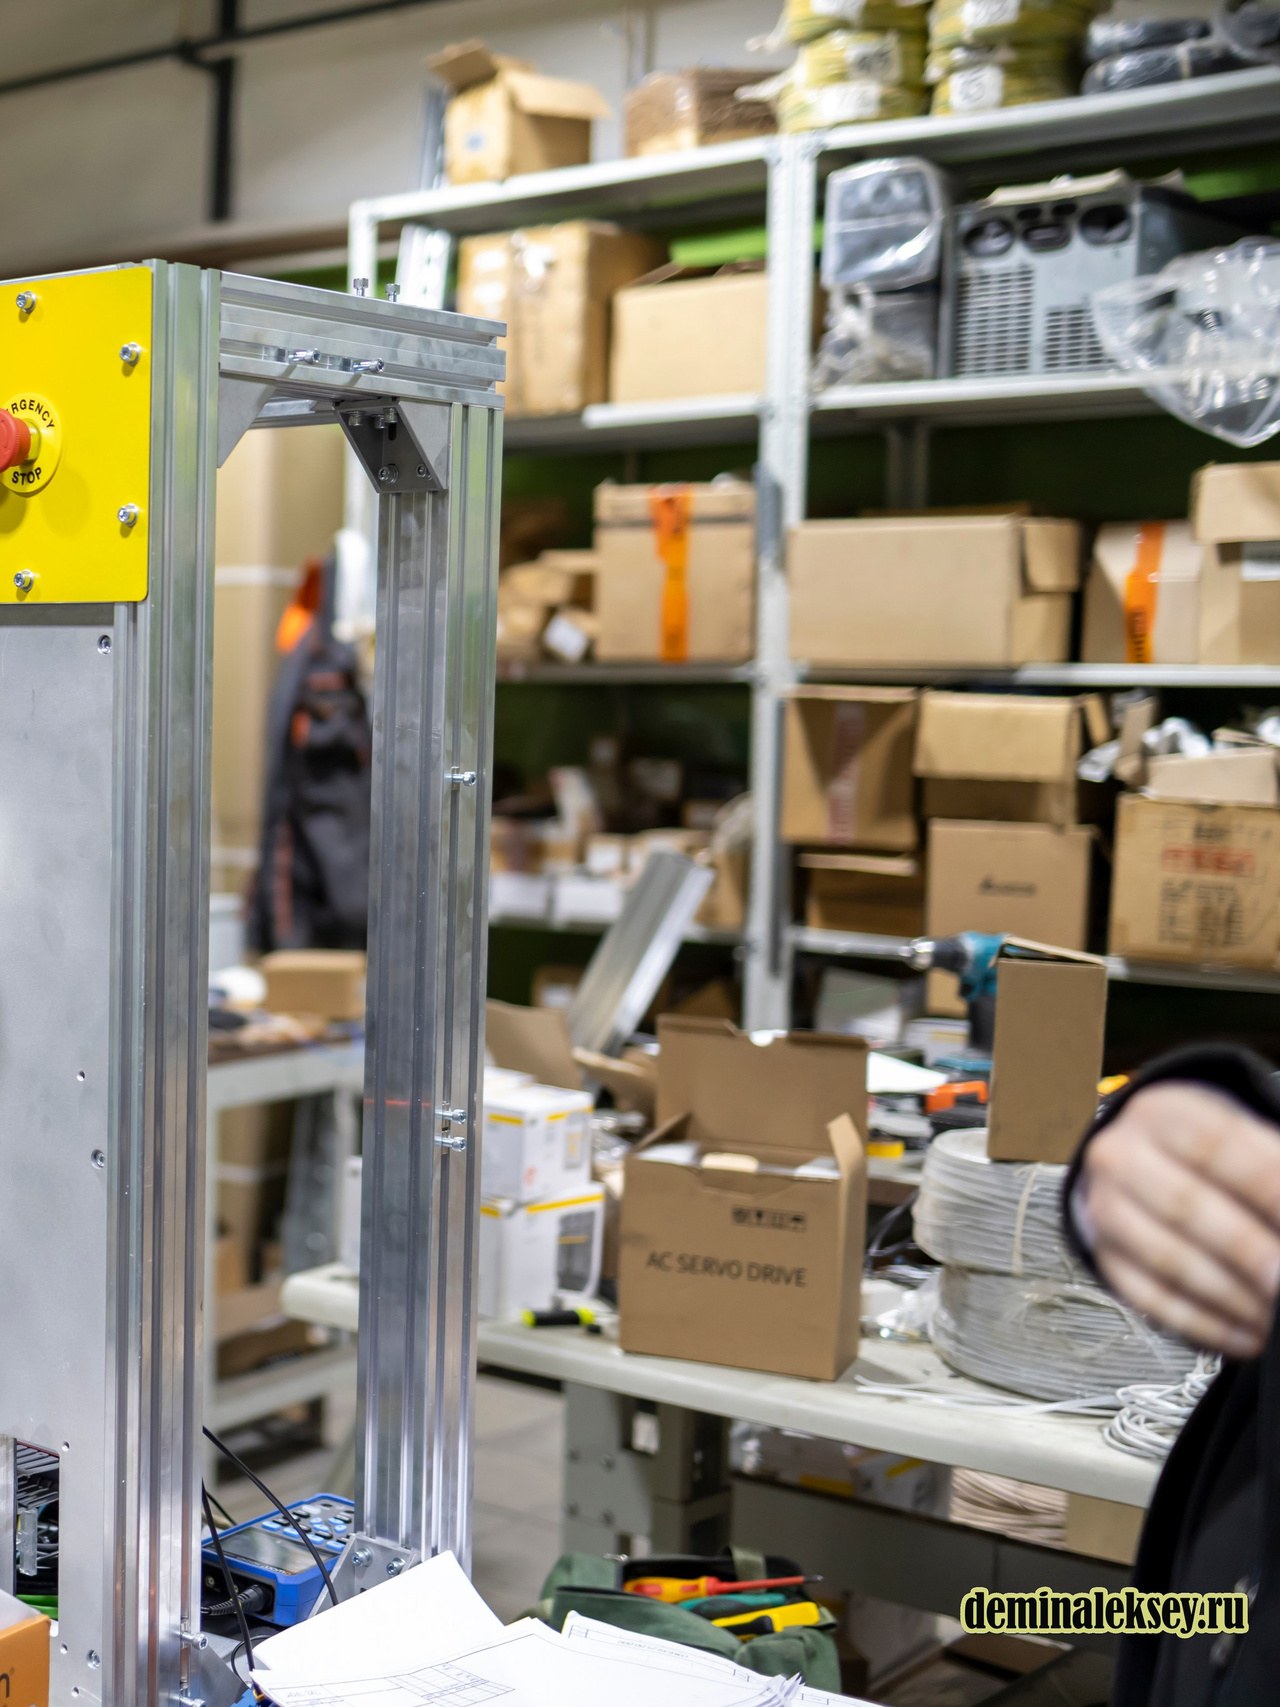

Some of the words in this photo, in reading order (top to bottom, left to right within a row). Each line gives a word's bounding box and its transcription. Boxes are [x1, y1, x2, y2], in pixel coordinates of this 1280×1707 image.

[7, 399, 55, 428] RGENCY
[12, 467, 41, 485] STOP
[646, 1251, 672, 1272] AC
[677, 1253, 742, 1280] SERVO
[747, 1262, 807, 1287] DRIVE
